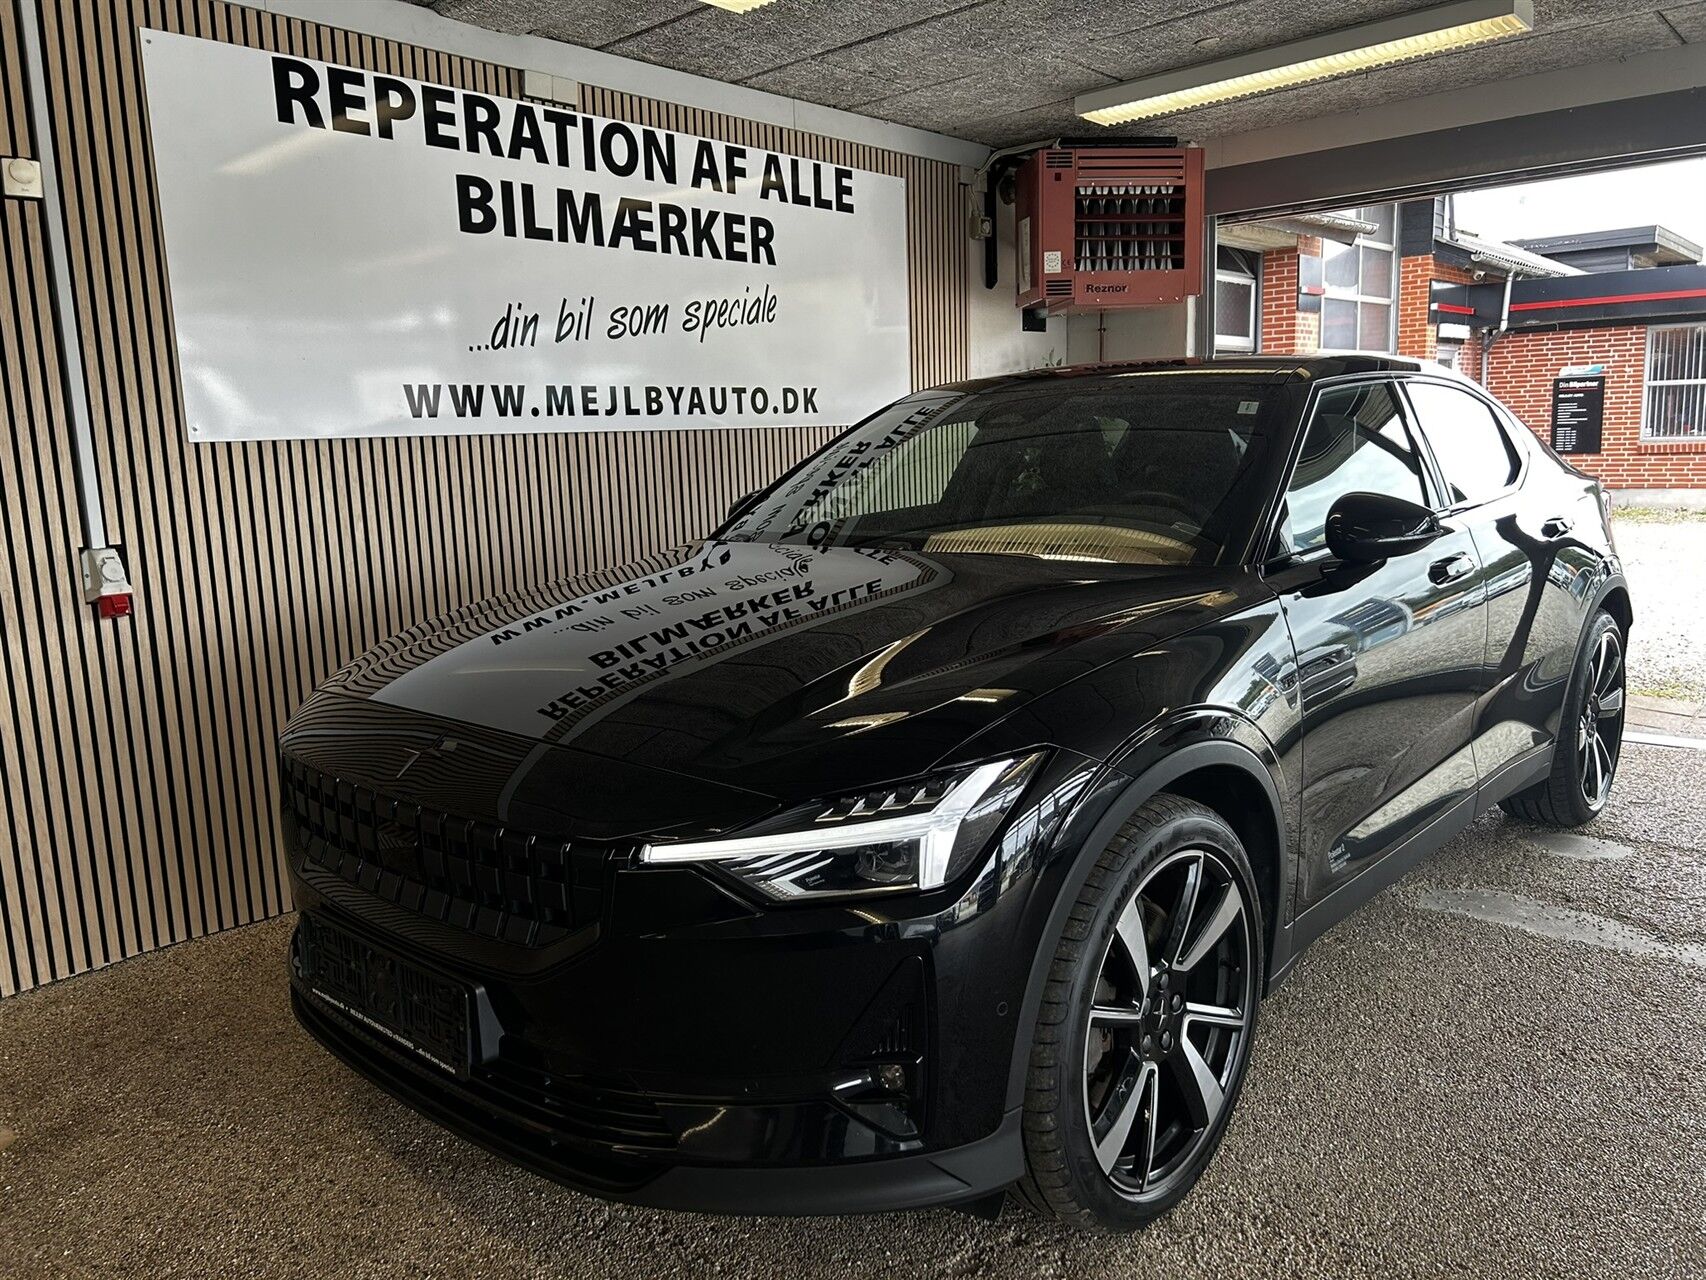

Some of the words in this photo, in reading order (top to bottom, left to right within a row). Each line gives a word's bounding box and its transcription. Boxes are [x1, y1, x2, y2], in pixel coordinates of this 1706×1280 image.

[272, 56, 677, 185] REPERATION
[691, 139, 747, 195] AF
[760, 153, 855, 214] ALLE
[456, 173, 777, 266] BILMÆRKER
[554, 296, 594, 344] bil
[607, 302, 671, 341] som
[682, 284, 777, 344] speciale
[1085, 284, 1128, 294] Reznor
[403, 383, 819, 418] WWW.MEJLBYAUTO.DK
